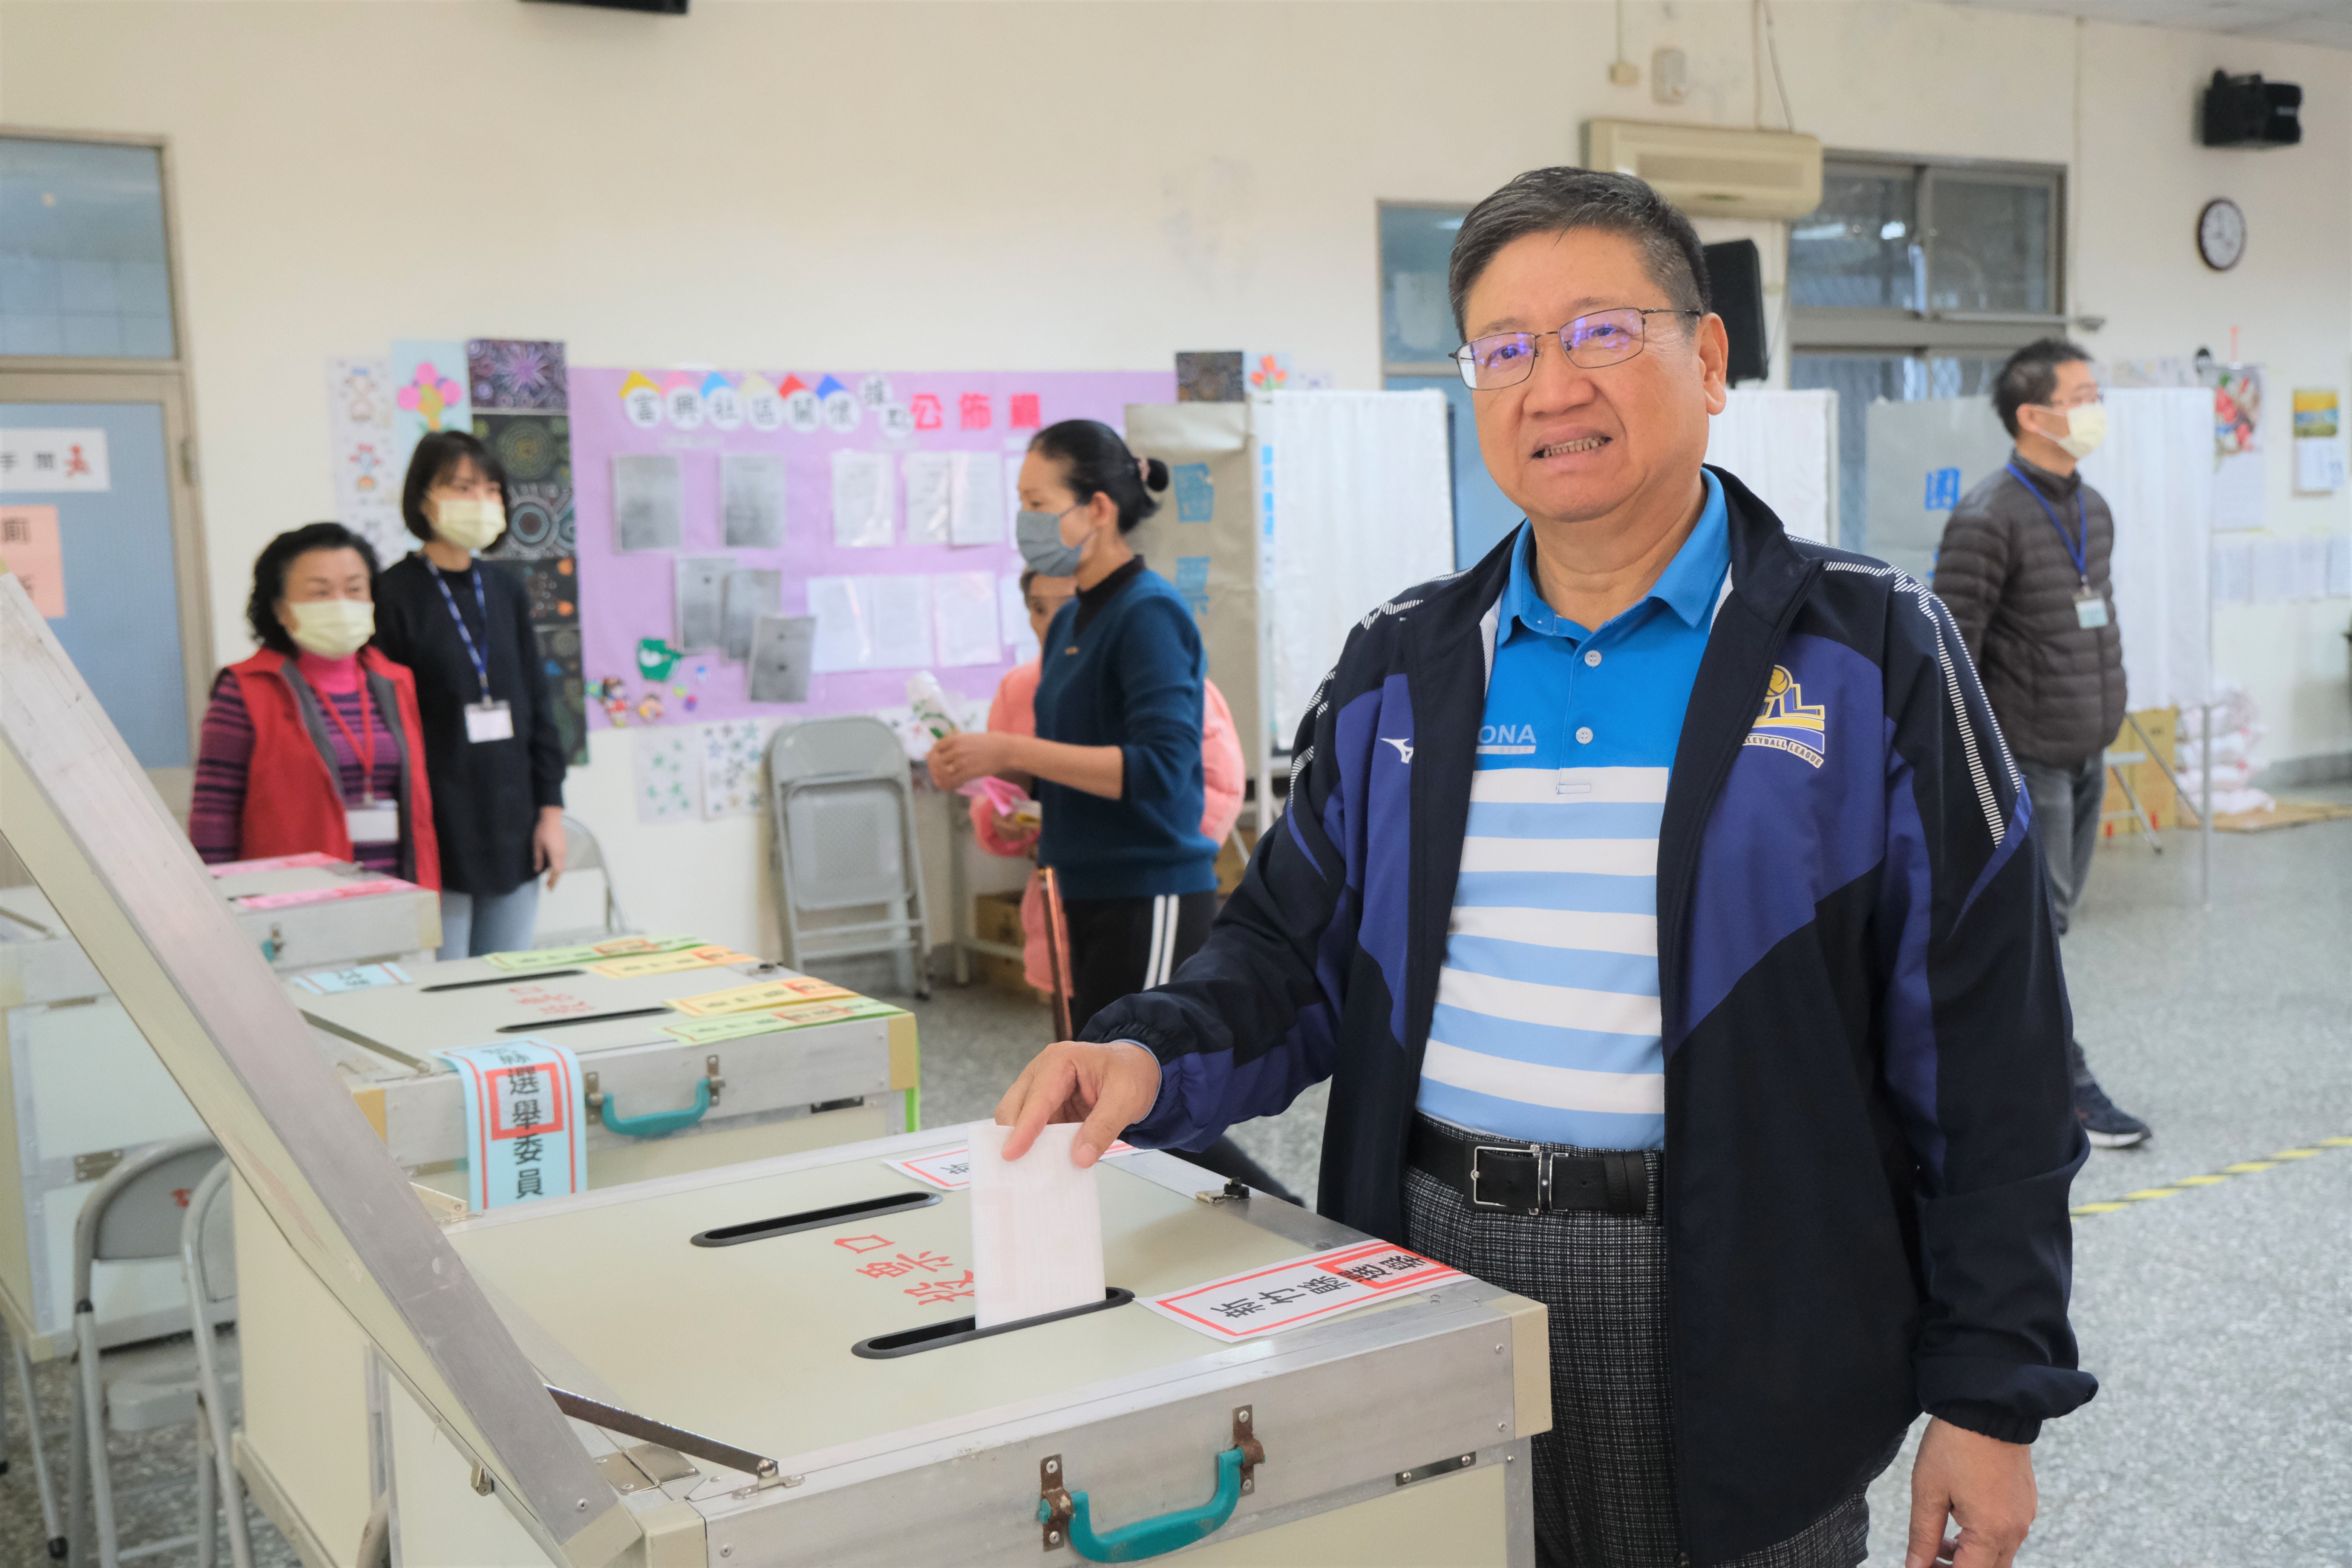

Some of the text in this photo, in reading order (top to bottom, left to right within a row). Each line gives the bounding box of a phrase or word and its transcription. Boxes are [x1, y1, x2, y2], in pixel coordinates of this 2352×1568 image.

[1478, 724, 1536, 743] ONA
[1790, 744, 1821, 766] LEAGUE
[1210, 1254, 1426, 1319] 新竹縣選舉
